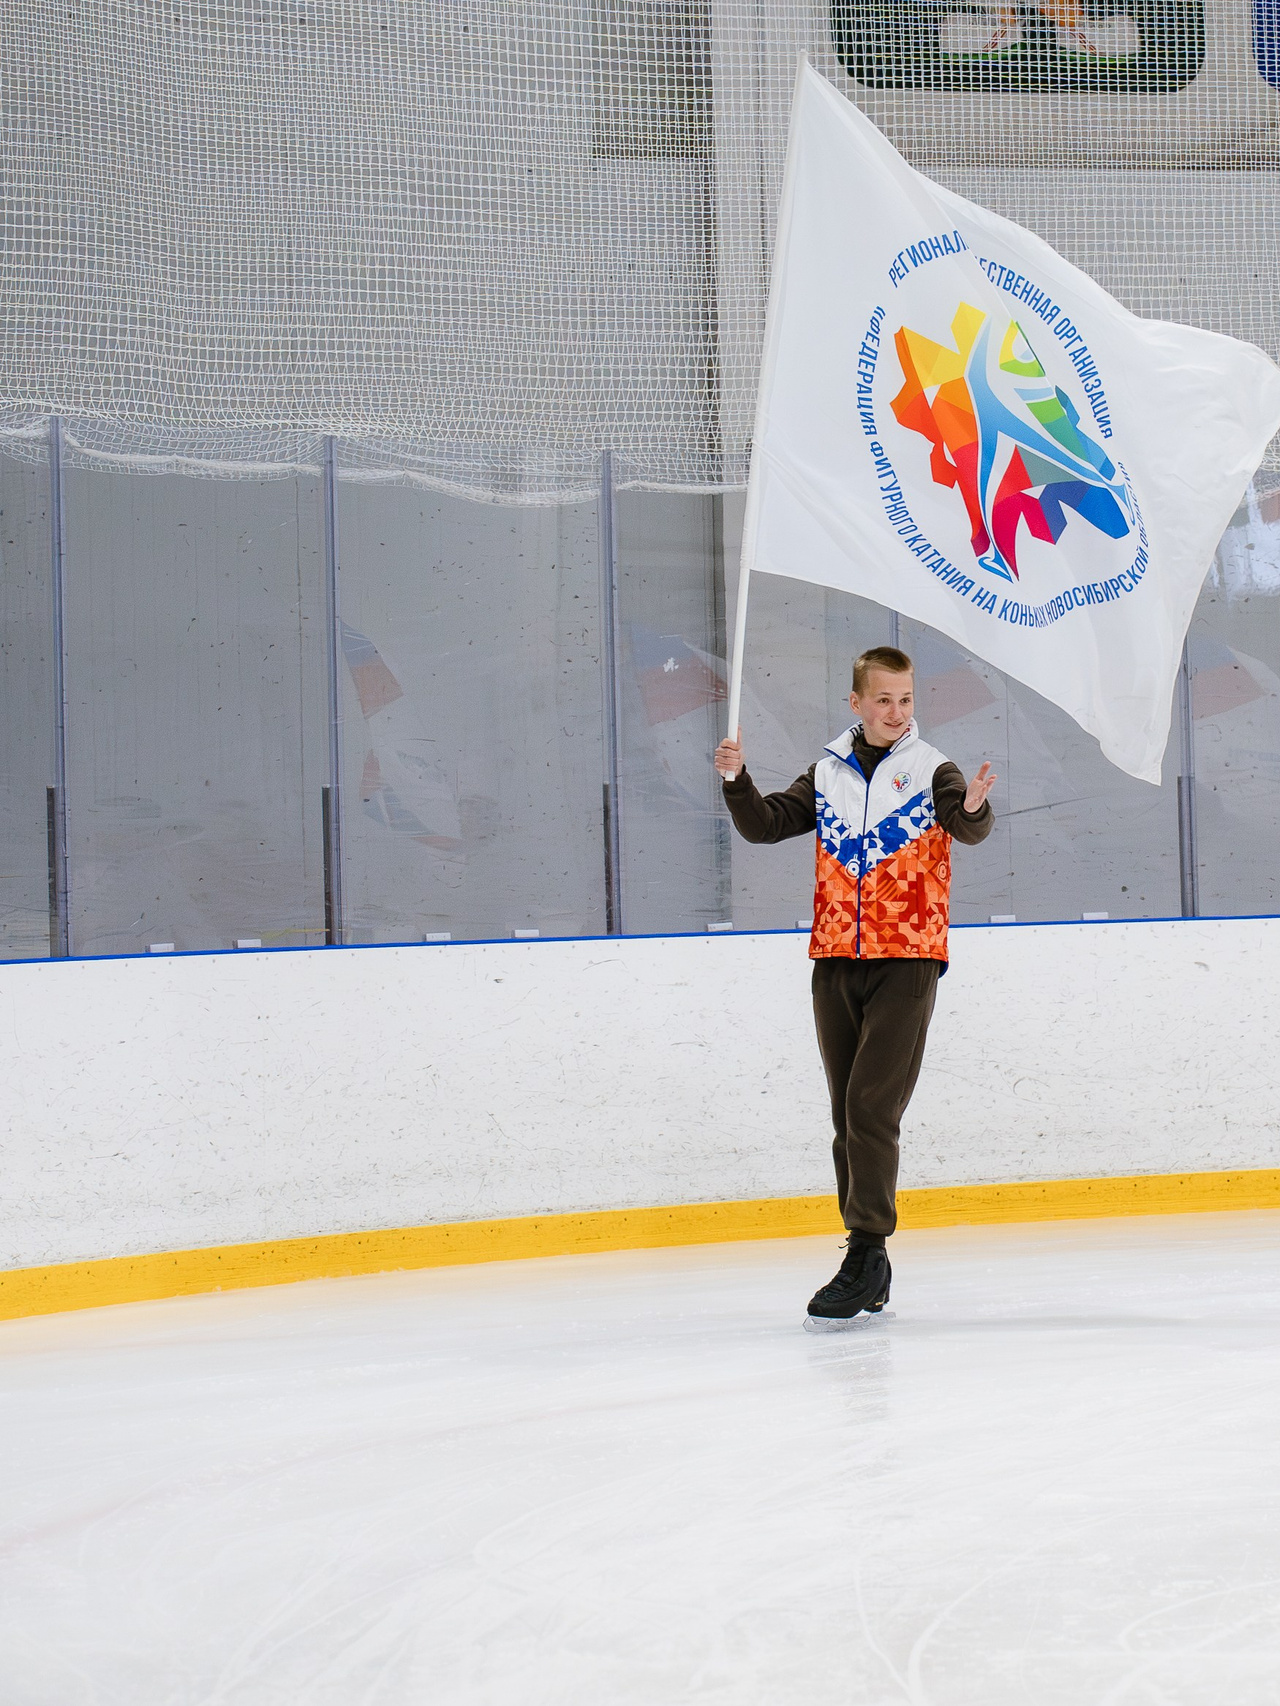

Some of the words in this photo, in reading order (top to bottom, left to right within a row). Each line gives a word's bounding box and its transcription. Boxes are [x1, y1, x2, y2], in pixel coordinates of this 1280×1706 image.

[856, 305, 887, 436] «ФЕДЕРАЦИЯ
[889, 229, 970, 289] РЕГИОНАЛ
[974, 256, 1062, 326] ЕСТВЕННАЯ
[1053, 317, 1113, 440] ОРГАНИЗАЦИЯ
[870, 441, 919, 536] ФИГУРНОГО
[904, 533, 976, 597] КАТАНИЯ
[971, 586, 998, 615] НА
[1044, 545, 1150, 625] НОВОСИБИРСКОЙ
